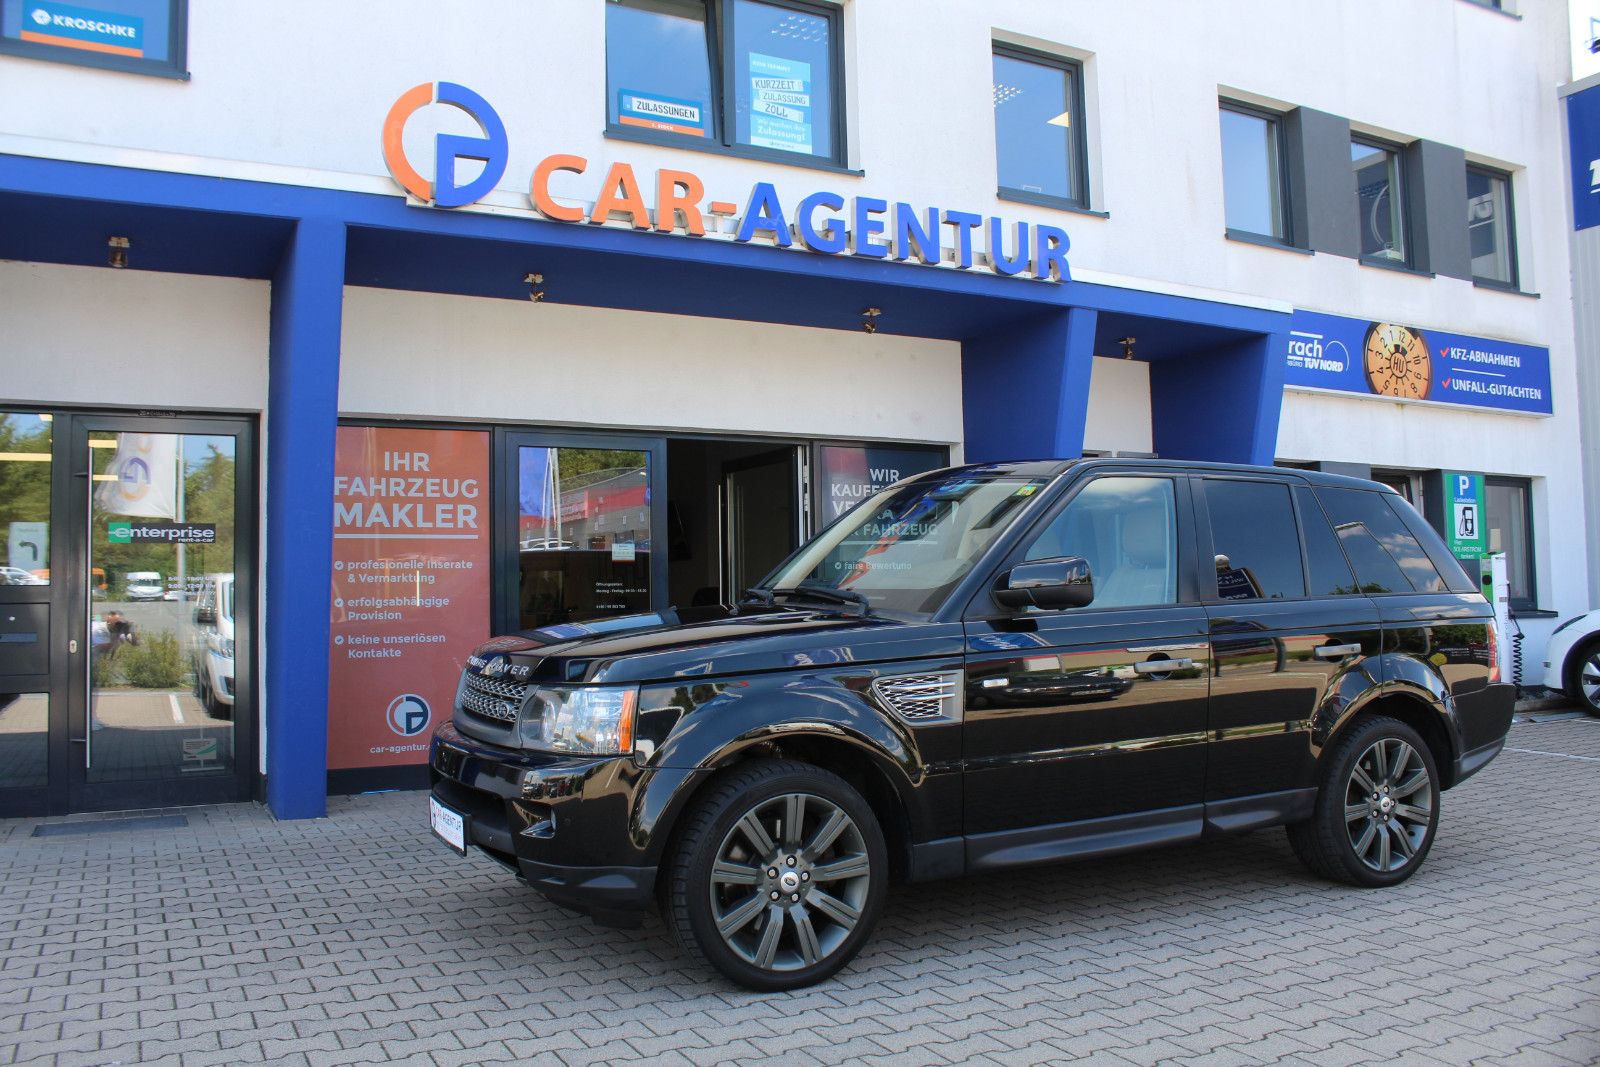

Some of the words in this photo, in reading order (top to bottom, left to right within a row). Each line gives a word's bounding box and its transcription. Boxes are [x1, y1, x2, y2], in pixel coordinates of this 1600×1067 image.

[53, 15, 136, 38] KROSCHKE
[755, 79, 795, 90] KURZZEIT
[763, 92, 806, 104] ZULASSUNG
[636, 101, 695, 119] ZULASSUNGEN
[765, 103, 788, 118] ZOLL
[530, 153, 1072, 283] CAR-AGENTUR
[1450, 347, 1521, 368] KFZ-ABNAHMEN
[1304, 358, 1320, 370] TÜV
[1320, 360, 1344, 373] NORD
[1394, 358, 1405, 374] HU
[1452, 378, 1542, 400] UNFALL-GUTACHTEN
[384, 451, 430, 472] IHR
[870, 468, 900, 482] WIR
[334, 476, 479, 499] FAHRZEUG
[831, 483, 885, 497] KAUFE
[1459, 475, 1470, 496] P
[334, 502, 478, 529] MAKLER
[114, 526, 215, 541] enterprise
[428, 560, 473, 570] Inserate
[348, 573, 355, 583] &
[359, 573, 436, 585] Vermarktung
[348, 596, 450, 608] erfolgsabhängige
[348, 611, 402, 621] Provision
[348, 635, 380, 645] keine
[383, 632, 446, 644] unseriösen
[348, 649, 402, 659] Kontakte
